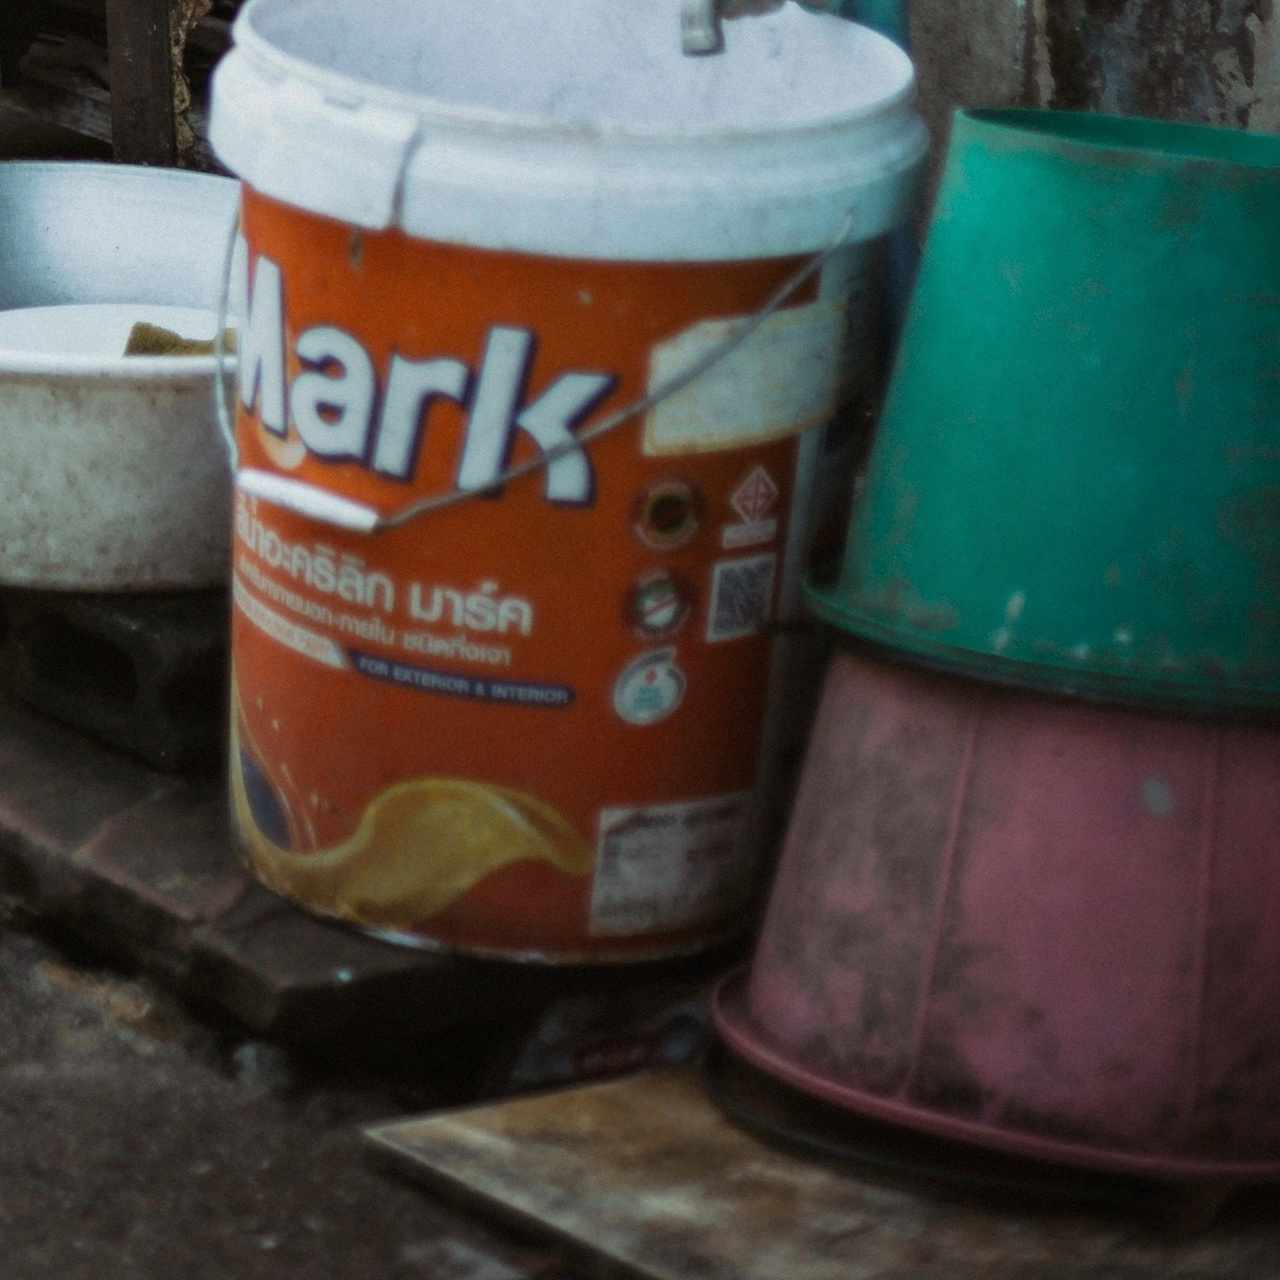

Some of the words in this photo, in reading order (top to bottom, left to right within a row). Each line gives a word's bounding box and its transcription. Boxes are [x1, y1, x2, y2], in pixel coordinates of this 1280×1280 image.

[235, 230, 617, 507] Mark
[358, 656, 389, 677] FOR
[392, 665, 469, 695] EXTERIOR
[490, 683, 569, 704] INTERIOR
